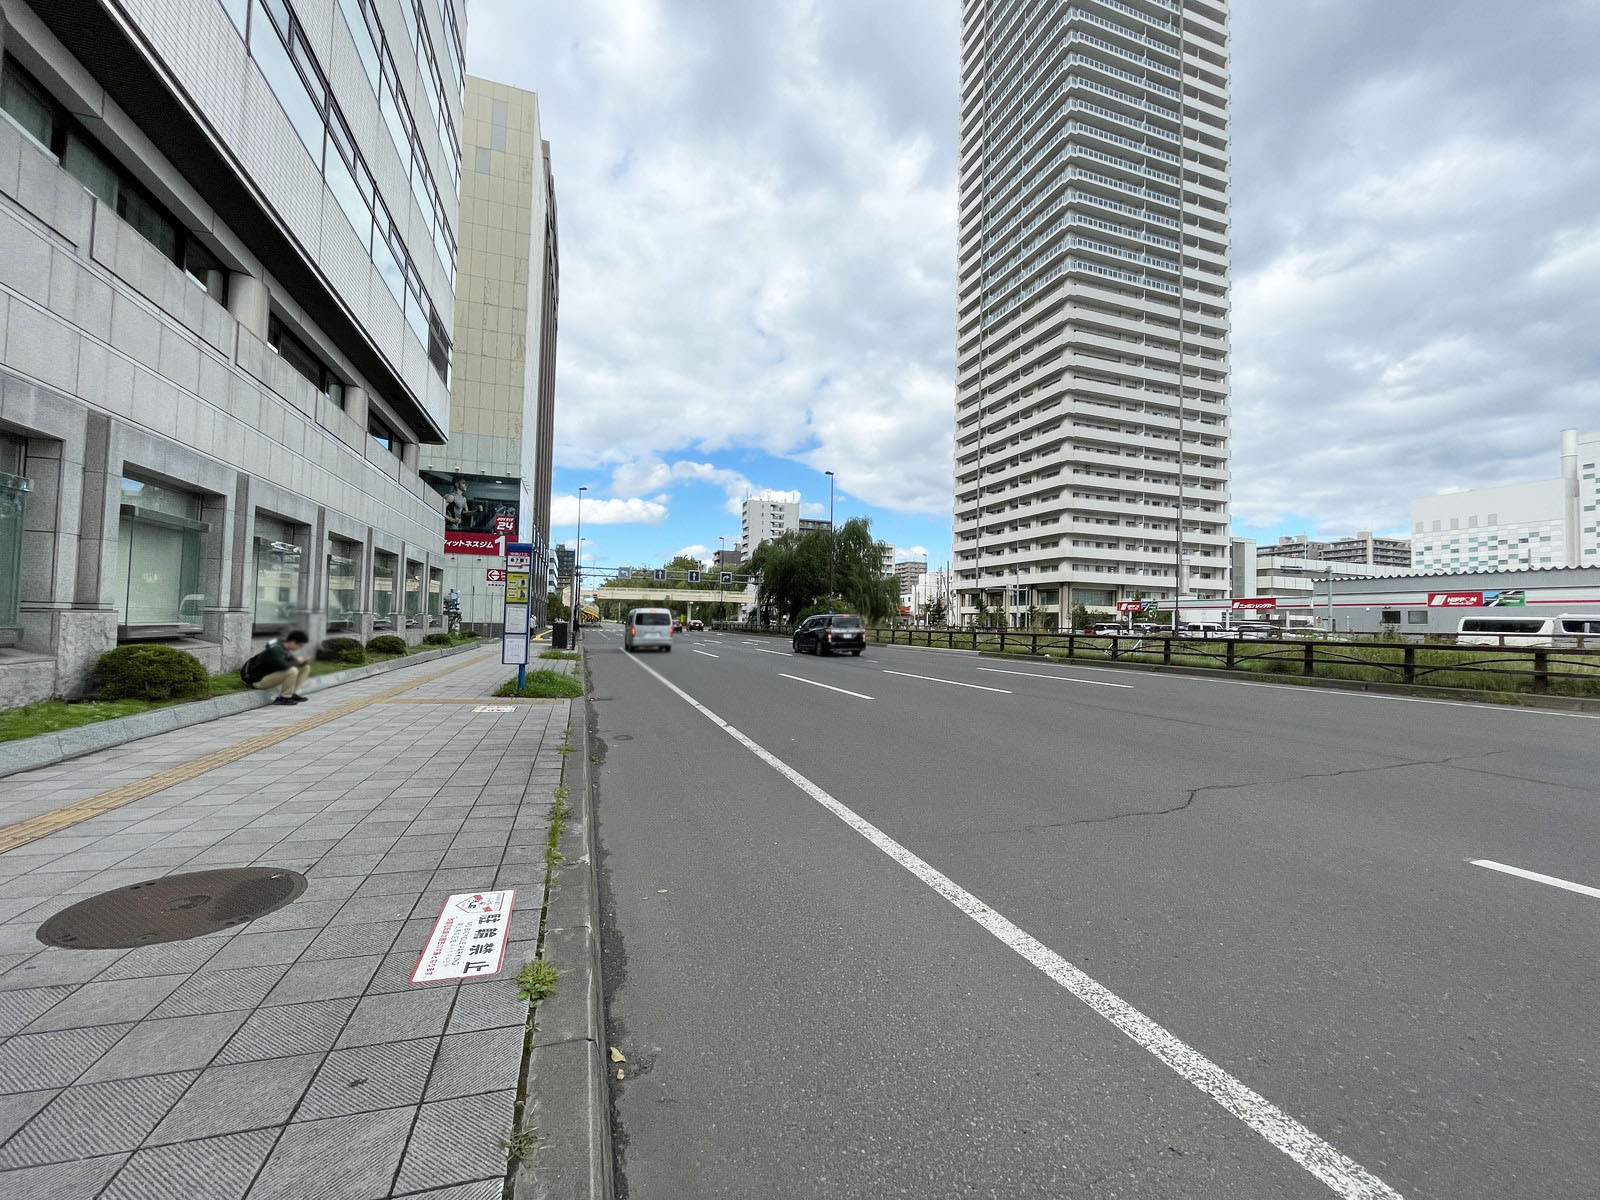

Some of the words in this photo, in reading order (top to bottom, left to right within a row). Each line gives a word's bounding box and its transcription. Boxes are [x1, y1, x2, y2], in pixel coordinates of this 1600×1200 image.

[496, 522, 514, 530] 24
[494, 536, 506, 556] 1
[463, 913, 501, 973] 駐輪禁止
